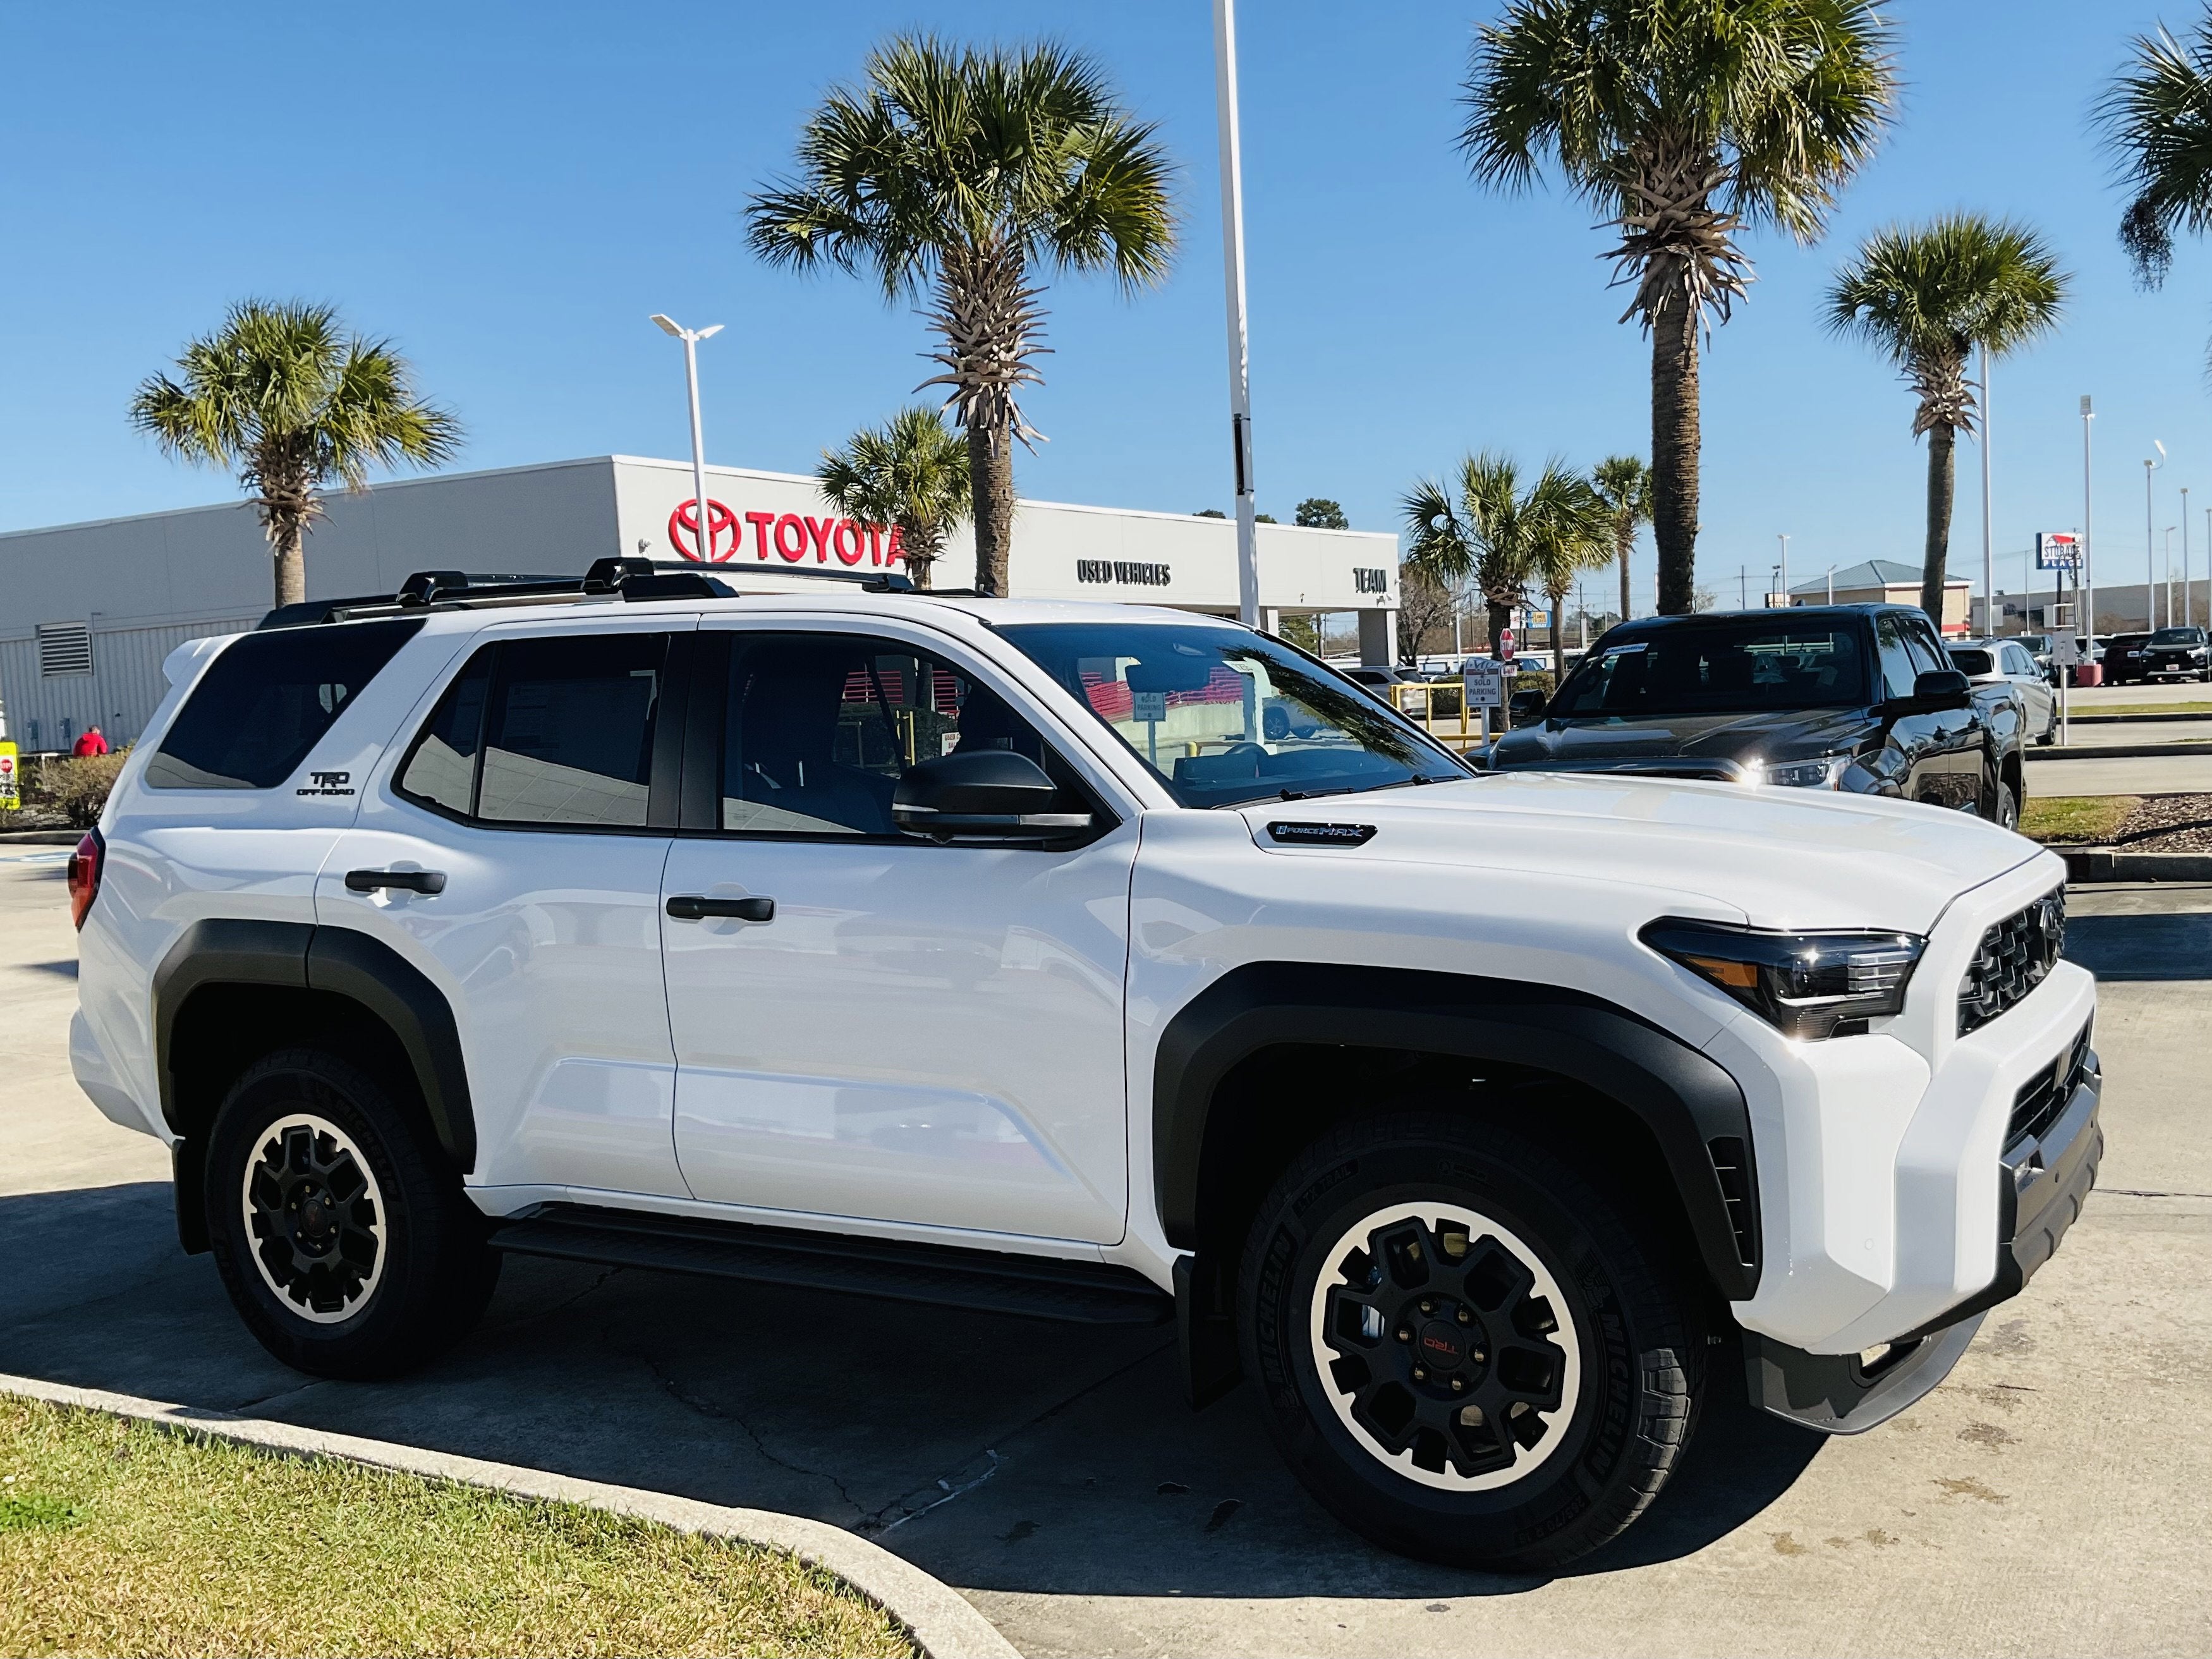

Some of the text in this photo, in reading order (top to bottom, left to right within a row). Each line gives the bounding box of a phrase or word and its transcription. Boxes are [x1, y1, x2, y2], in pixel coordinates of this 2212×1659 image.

[1077, 559, 1171, 586] USED VEHICLES
[1352, 568, 1387, 593] TEAM
[1502, 640, 1514, 650] STOP
[310, 772, 350, 788] TRD
[1591, 1313, 1629, 1476] MICHELIN
